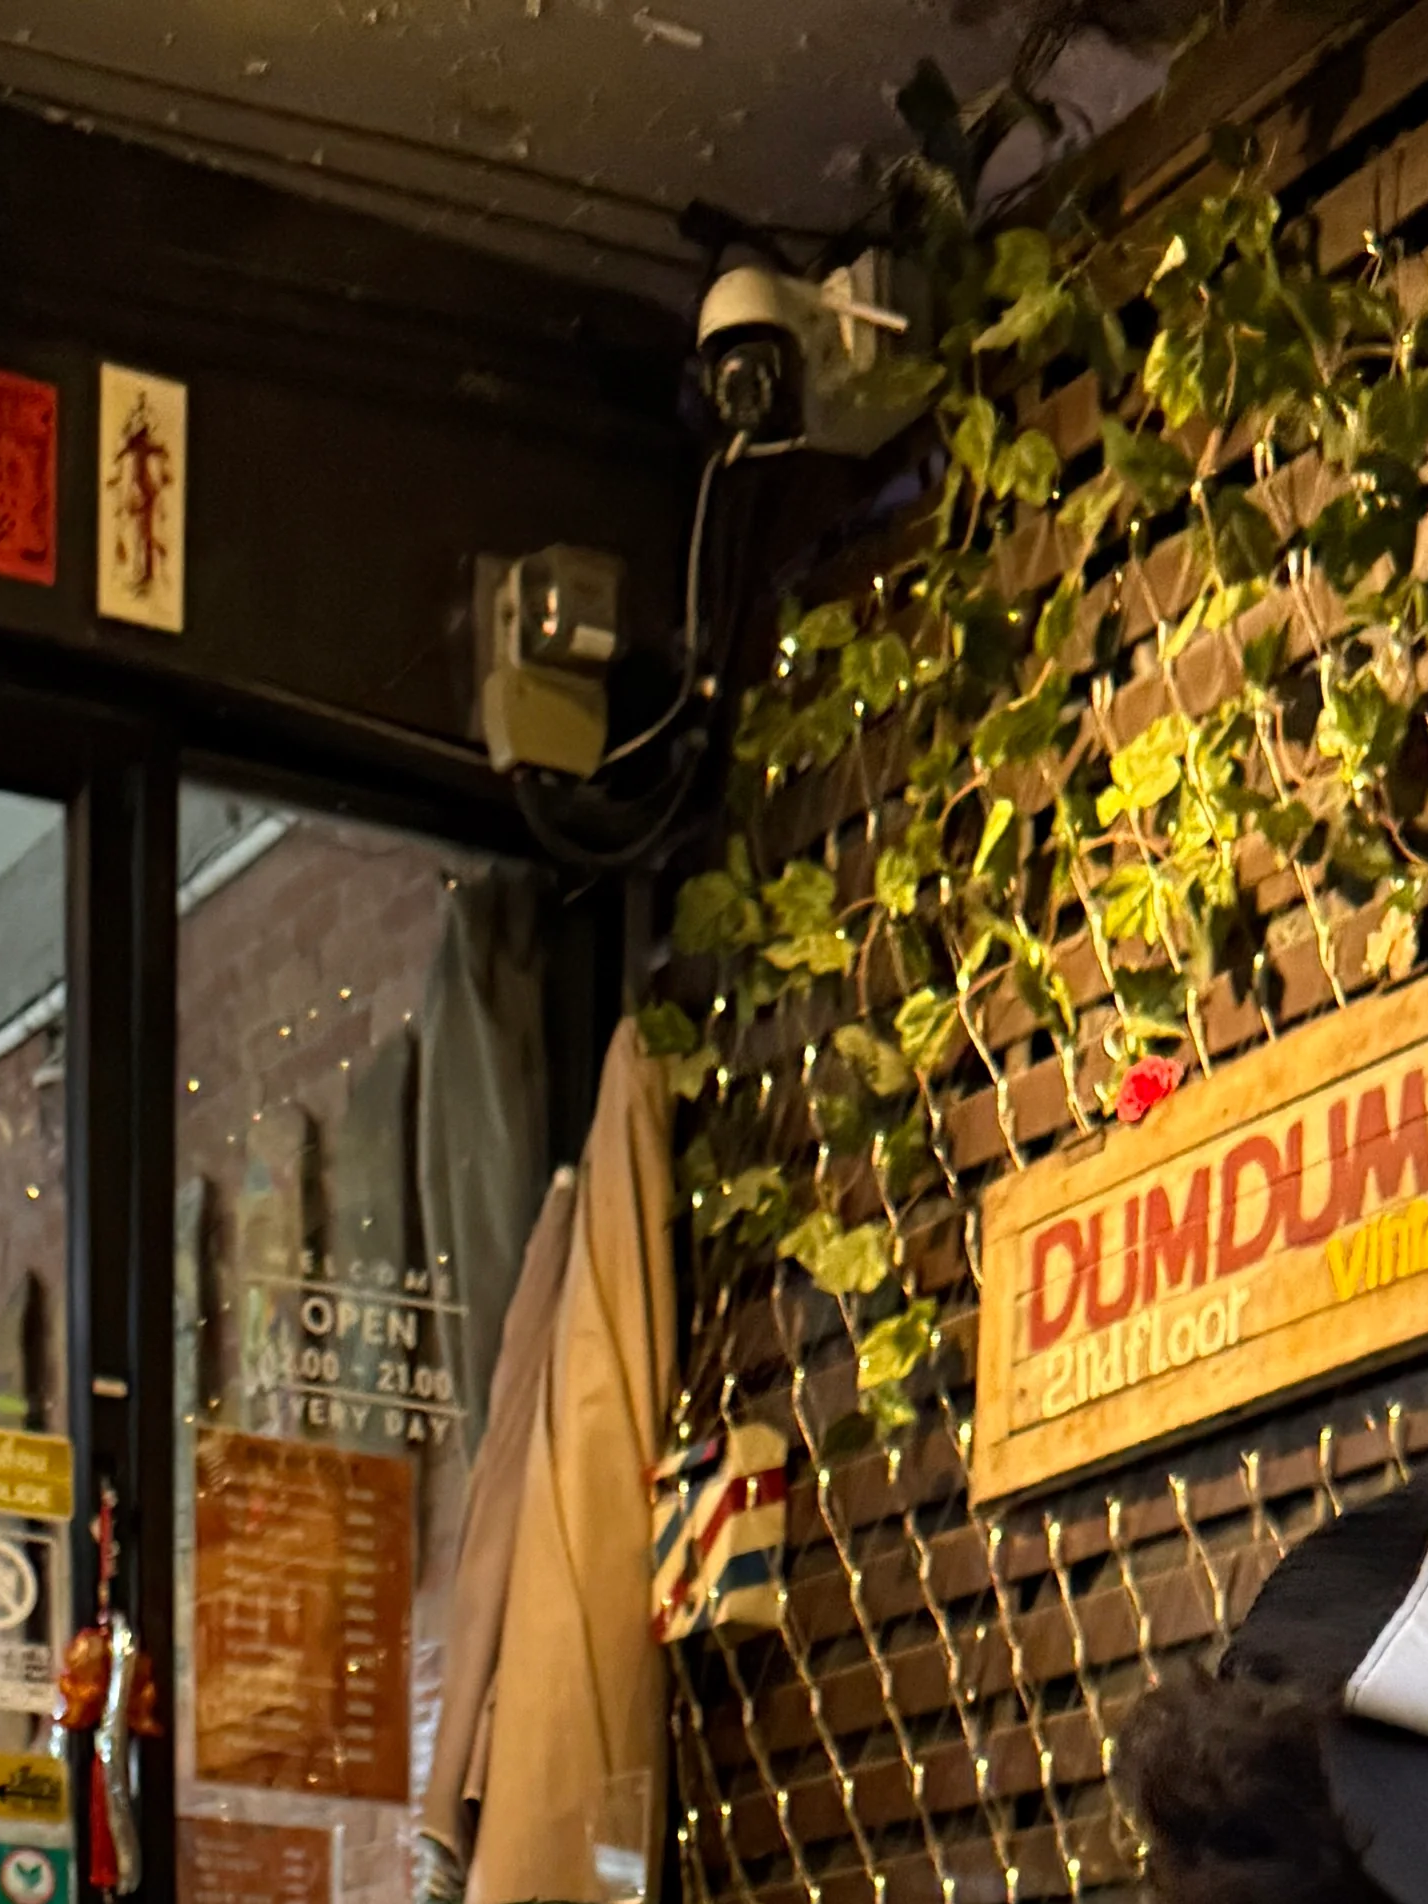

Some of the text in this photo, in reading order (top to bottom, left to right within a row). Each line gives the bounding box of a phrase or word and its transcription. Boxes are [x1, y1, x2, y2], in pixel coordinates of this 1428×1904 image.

[267, 1244, 453, 1300] ELCOME
[301, 1296, 419, 1350] OPEN
[384, 1408, 452, 1446] DAY
